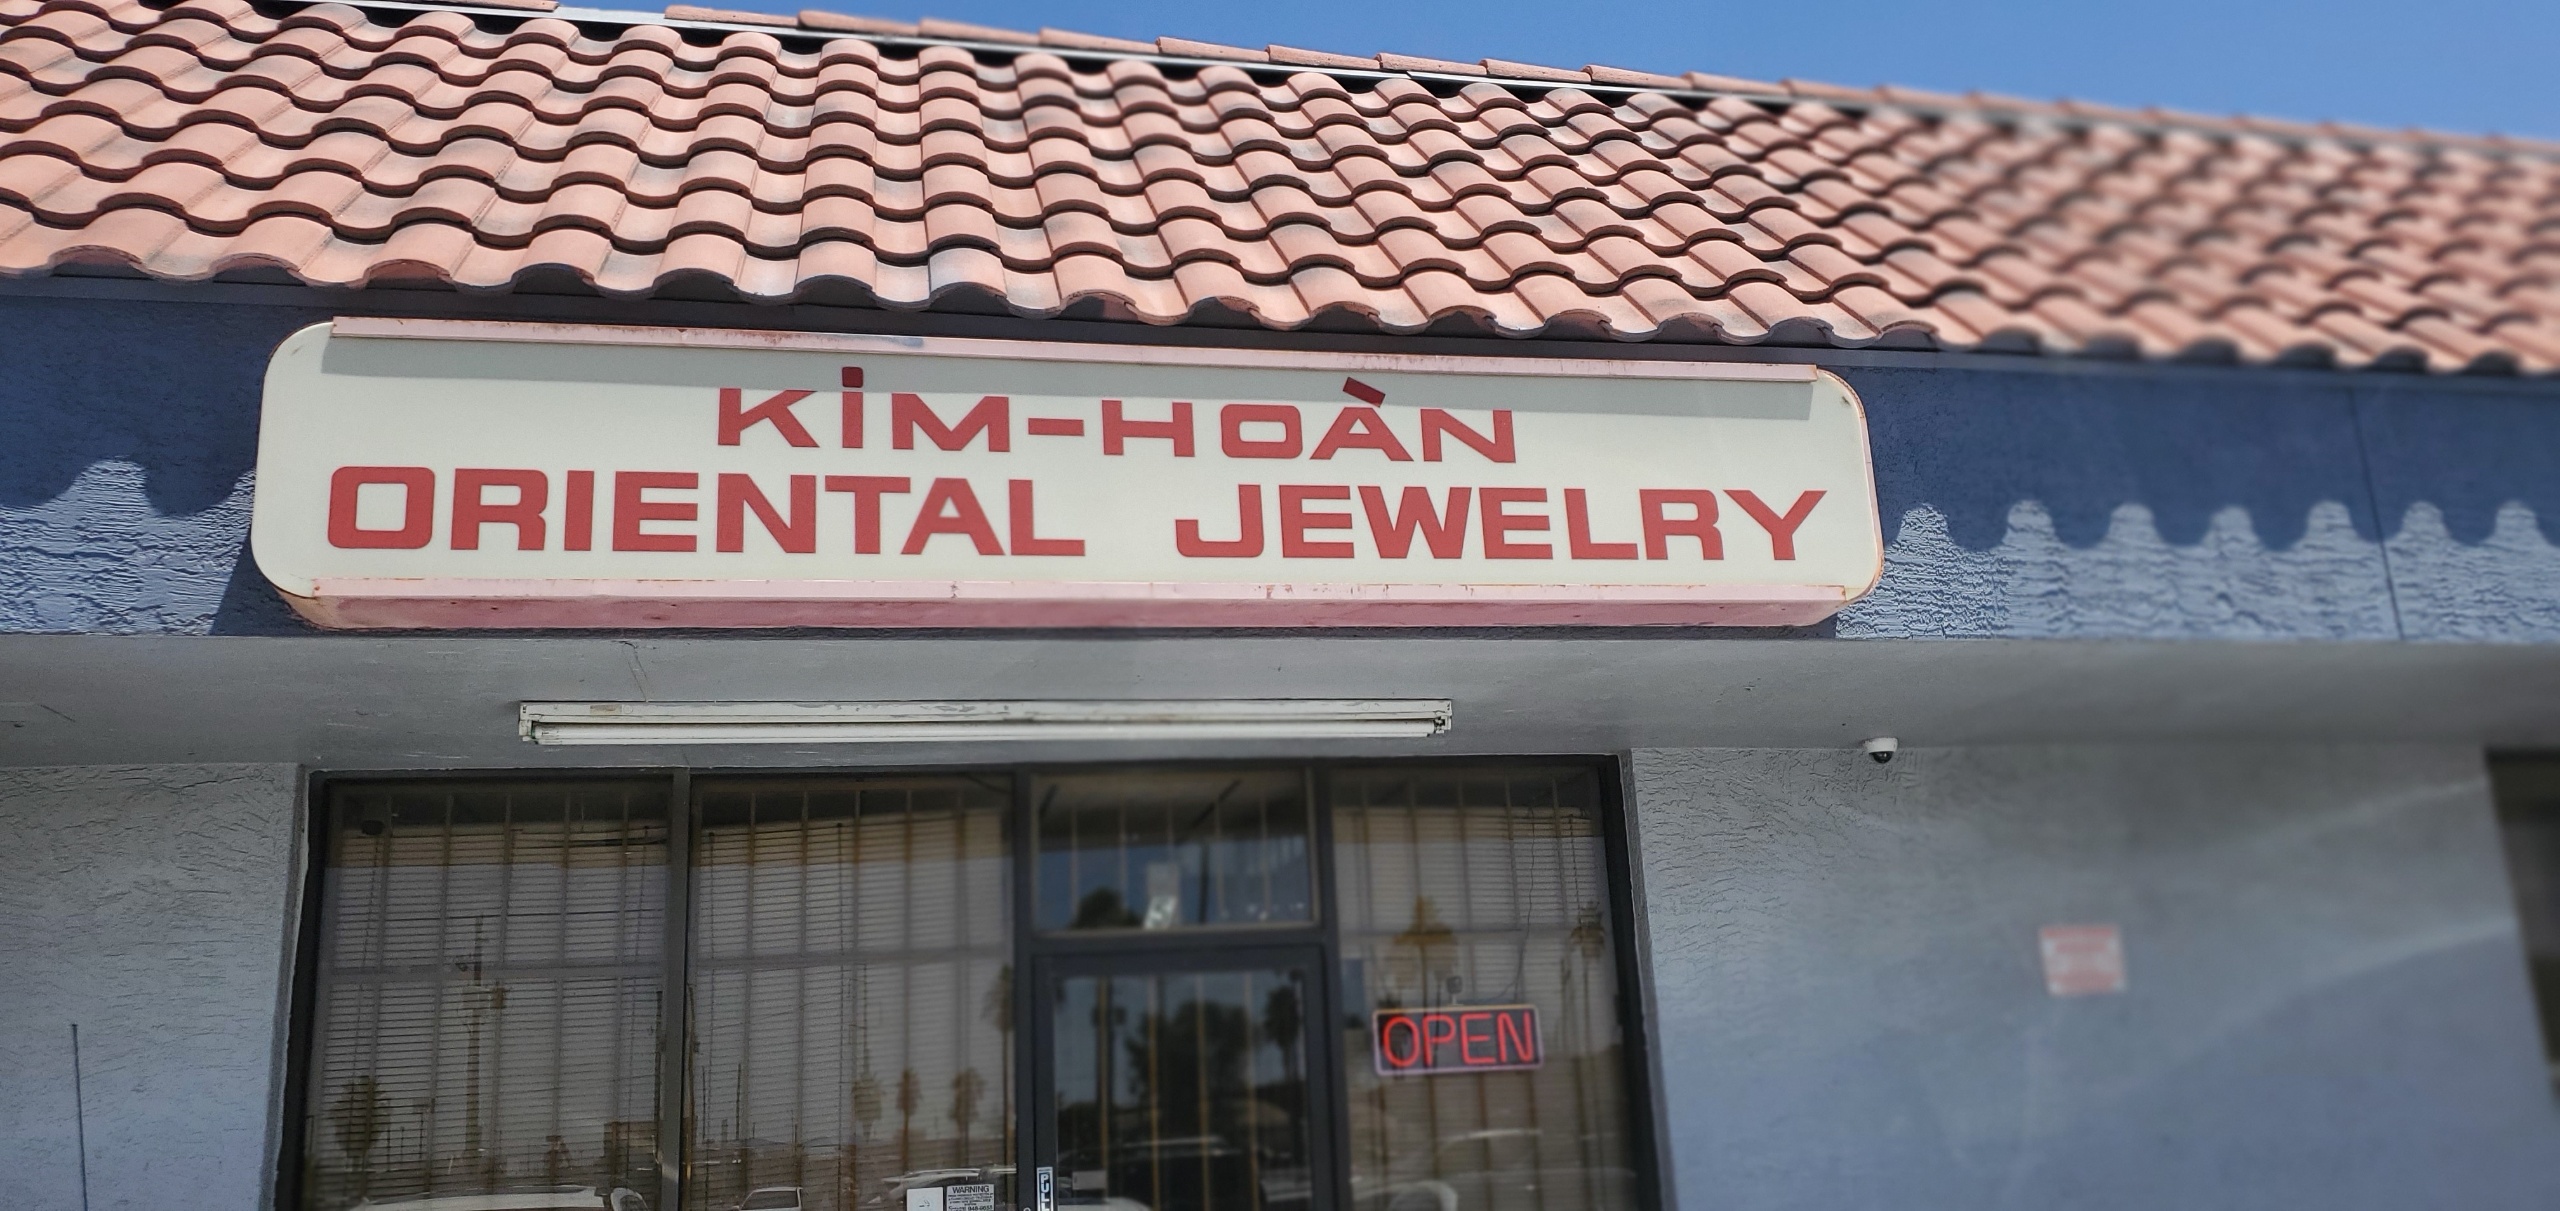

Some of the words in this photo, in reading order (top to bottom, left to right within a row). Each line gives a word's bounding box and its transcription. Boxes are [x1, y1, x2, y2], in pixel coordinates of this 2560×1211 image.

[327, 465, 1085, 556] ORIENTAL
[1175, 483, 1824, 561] JEWELRY
[1382, 1011, 1534, 1067] OPEN
[952, 1185, 990, 1194] WARNING
[1040, 1173, 1050, 1211] PULL
